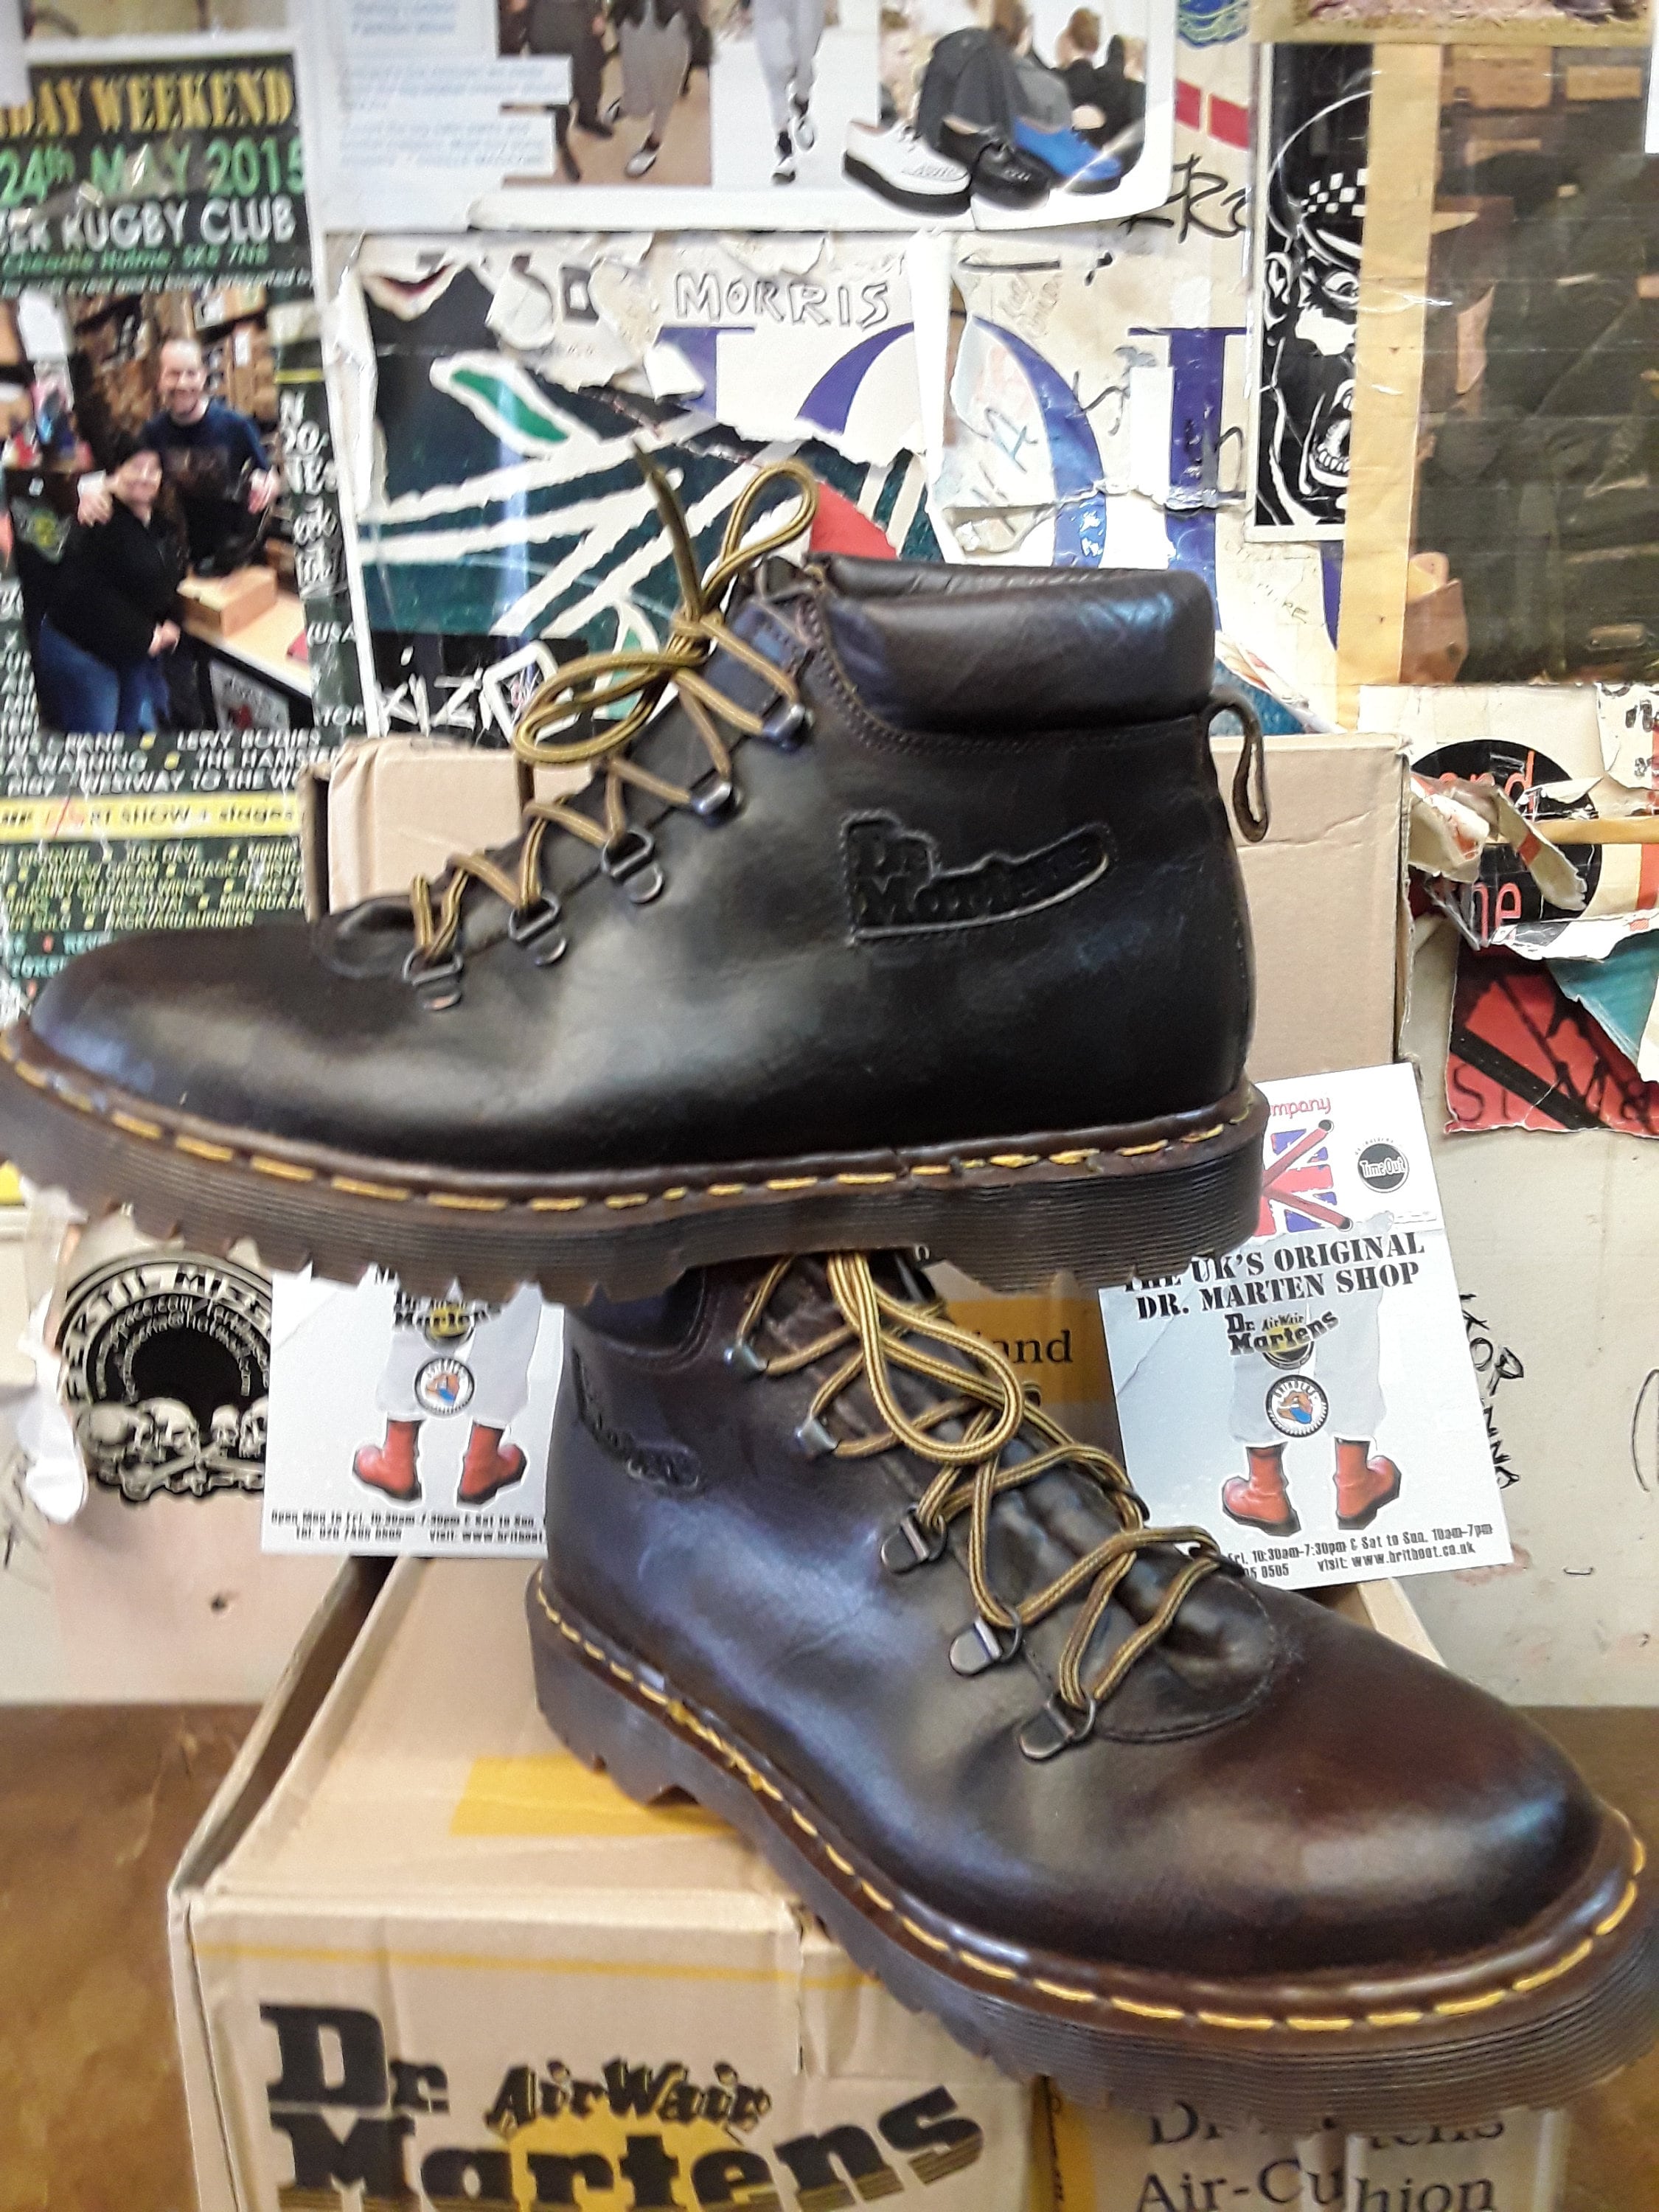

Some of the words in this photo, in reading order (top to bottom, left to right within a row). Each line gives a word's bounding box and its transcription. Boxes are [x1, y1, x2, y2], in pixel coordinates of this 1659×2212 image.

[90, 68, 293, 134] WEEKEND
[205, 136, 305, 198] 2015
[62, 200, 189, 251] RUGBY
[200, 194, 296, 245] CLUB
[674, 271, 890, 329] MORRIS
[1270, 1097, 1331, 1119] mpany
[1192, 1252, 1265, 1283] UK'S
[1274, 1232, 1425, 1271] ORIGINAL
[1136, 1293, 1189, 1319] DR.
[1200, 1274, 1326, 1312] MARTEN
[1337, 1261, 1420, 1294] SHOP
[1227, 1310, 1339, 1356] Martens
[1262, 1562, 1290, 1579] 0505
[1352, 1541, 1476, 1568] www.britboot.co.uk
[1361, 1535, 1383, 1550] Sat
[1387, 1534, 1399, 1546] to
[1432, 1523, 1493, 1541] 10am-7pm
[483, 2056, 773, 2143] AirWair
[270, 2085, 986, 2212] Martens
[1135, 2154, 1497, 2212] Air-Cuhion
